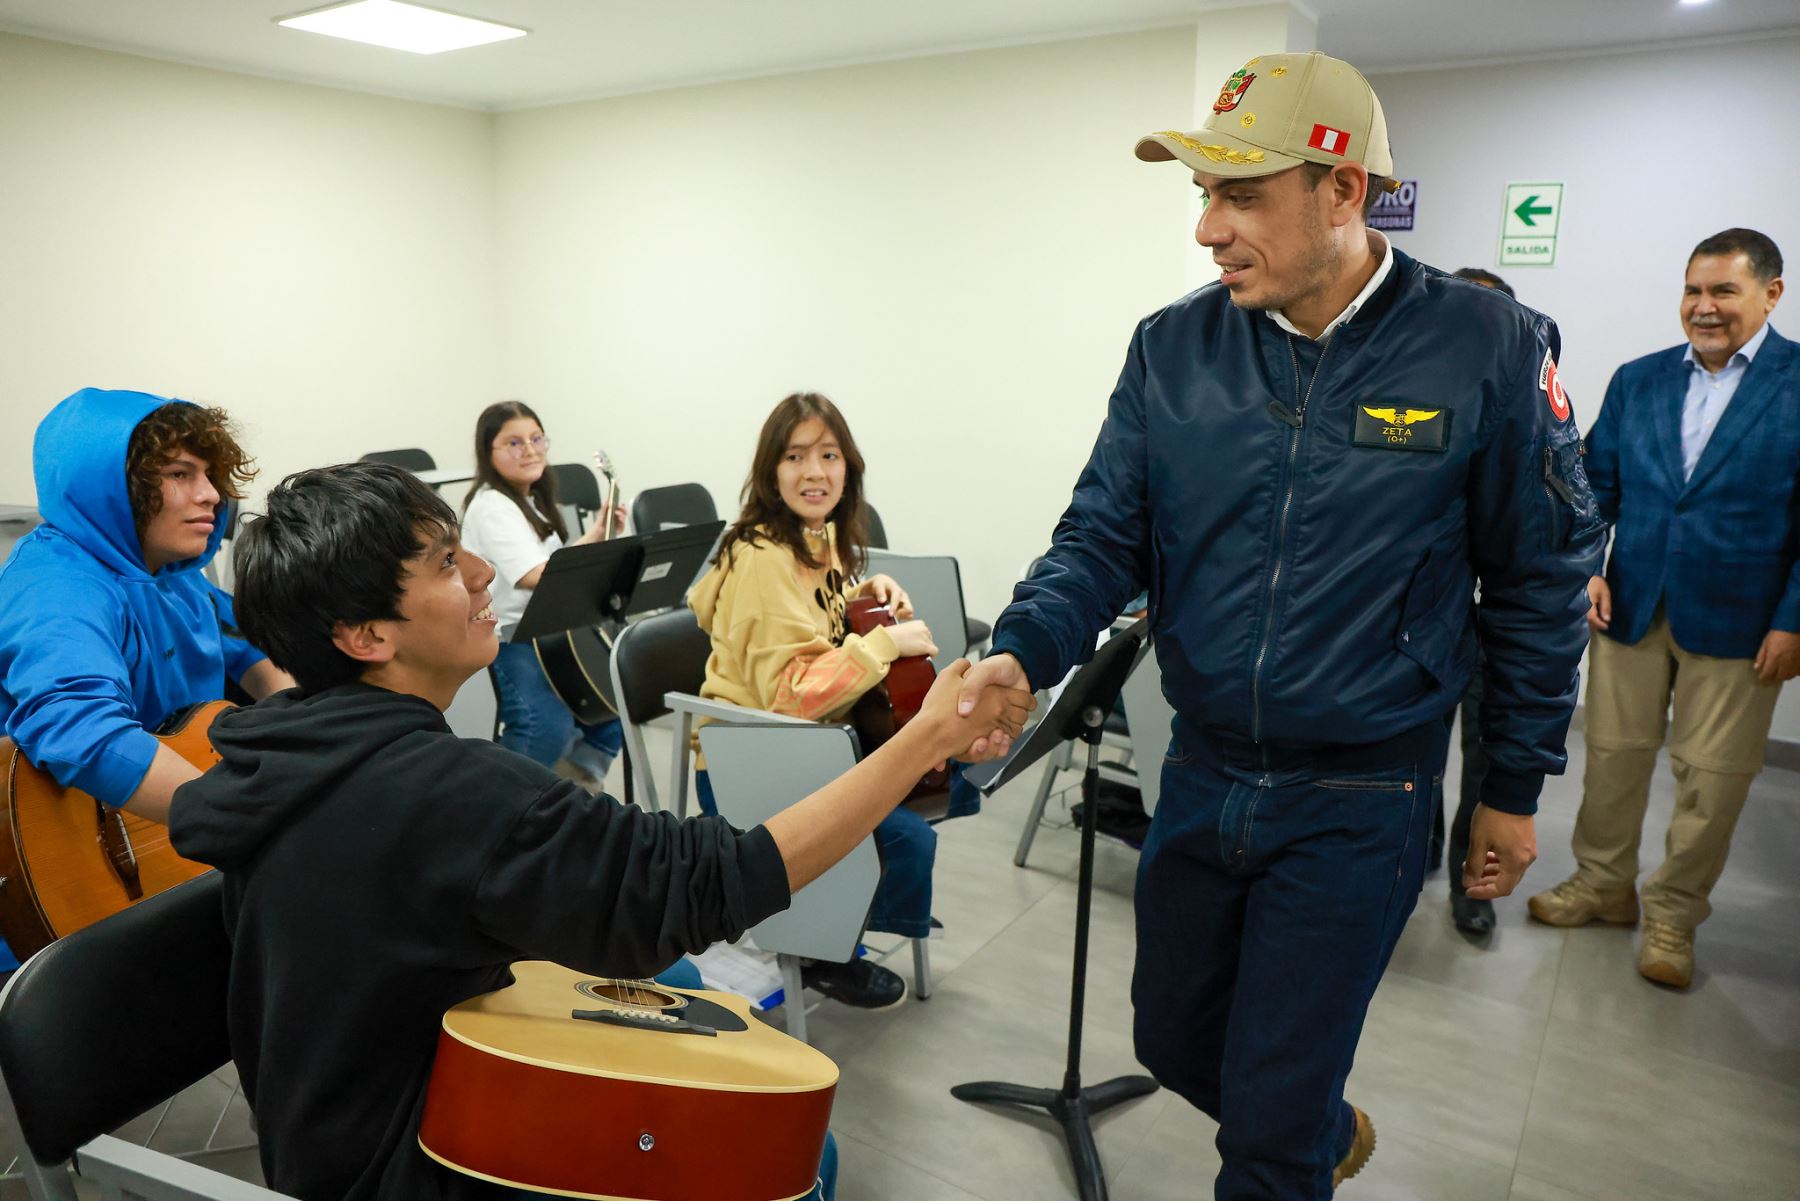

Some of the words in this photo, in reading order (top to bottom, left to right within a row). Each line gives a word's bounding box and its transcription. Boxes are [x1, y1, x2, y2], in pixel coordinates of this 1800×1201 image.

[1506, 246, 1550, 254] SALIDA
[1382, 427, 1412, 436] ZETA
[1387, 435, 1407, 445] (O+)
